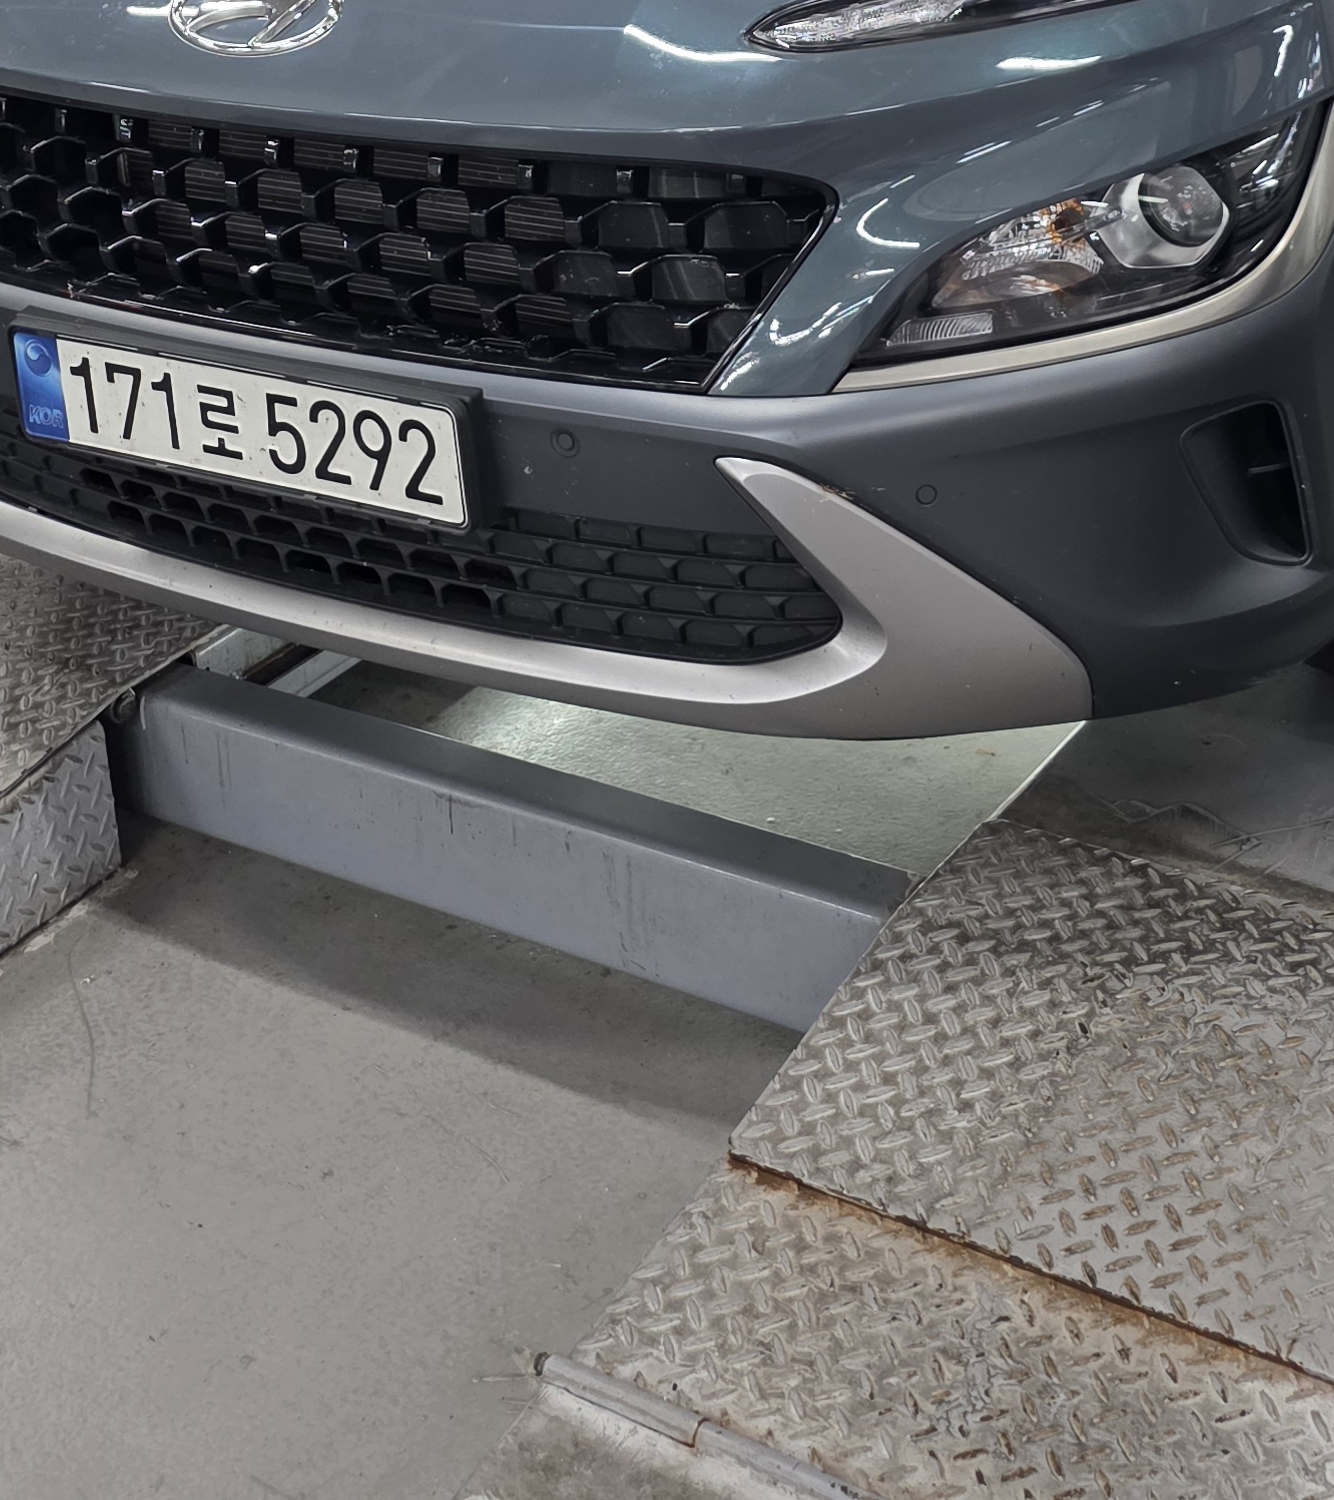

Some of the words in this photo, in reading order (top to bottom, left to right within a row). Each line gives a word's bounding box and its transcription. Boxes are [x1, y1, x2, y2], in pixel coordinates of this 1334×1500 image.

[28, 404, 63, 429] KOR
[69, 357, 244, 461] 171로
[265, 392, 444, 506] 5292
